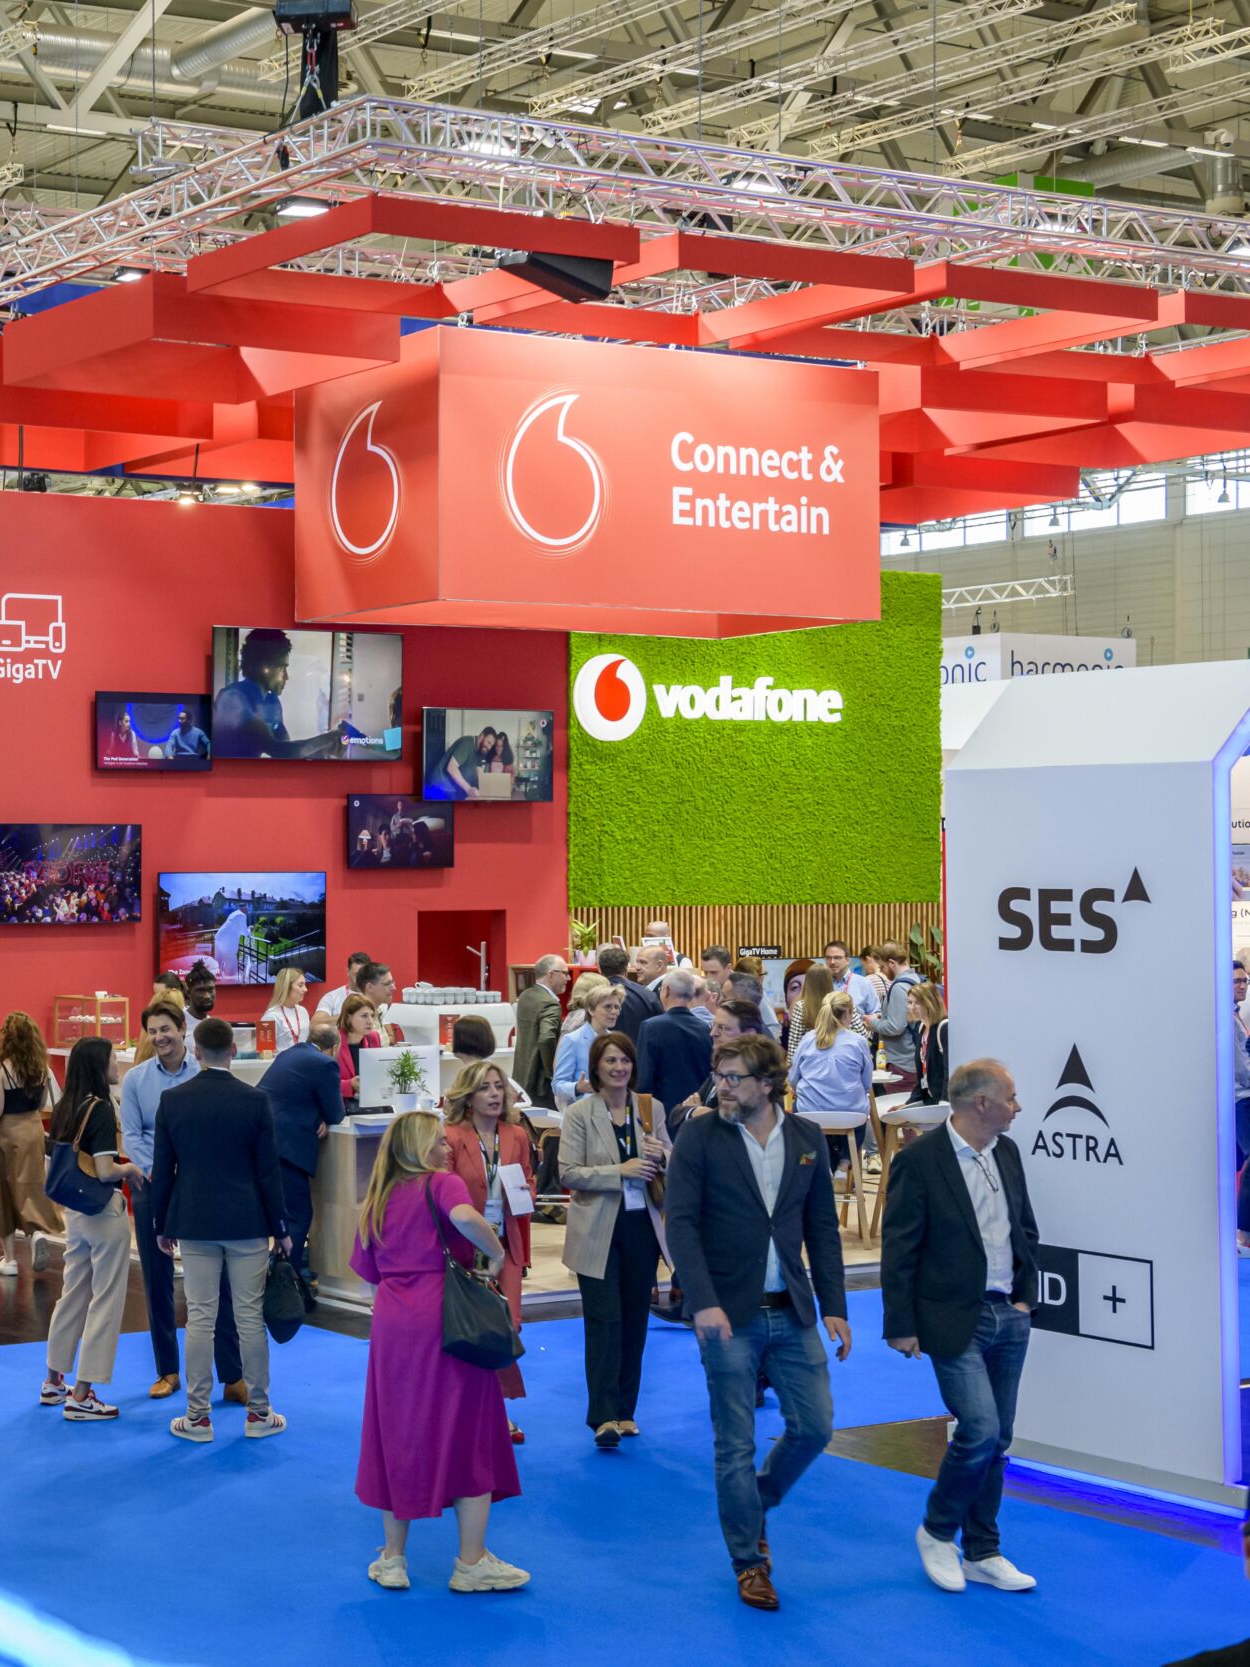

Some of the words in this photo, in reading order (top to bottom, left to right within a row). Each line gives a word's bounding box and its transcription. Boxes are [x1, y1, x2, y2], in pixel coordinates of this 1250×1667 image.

[670, 431, 813, 481] Connect
[819, 445, 845, 483] &
[672, 486, 830, 535] Entertain
[653, 675, 844, 723] vodafone
[997, 886, 1119, 954] SES
[739, 948, 761, 957] GigaTV
[760, 947, 778, 955] Home
[1031, 1129, 1124, 1166] ASTRA
